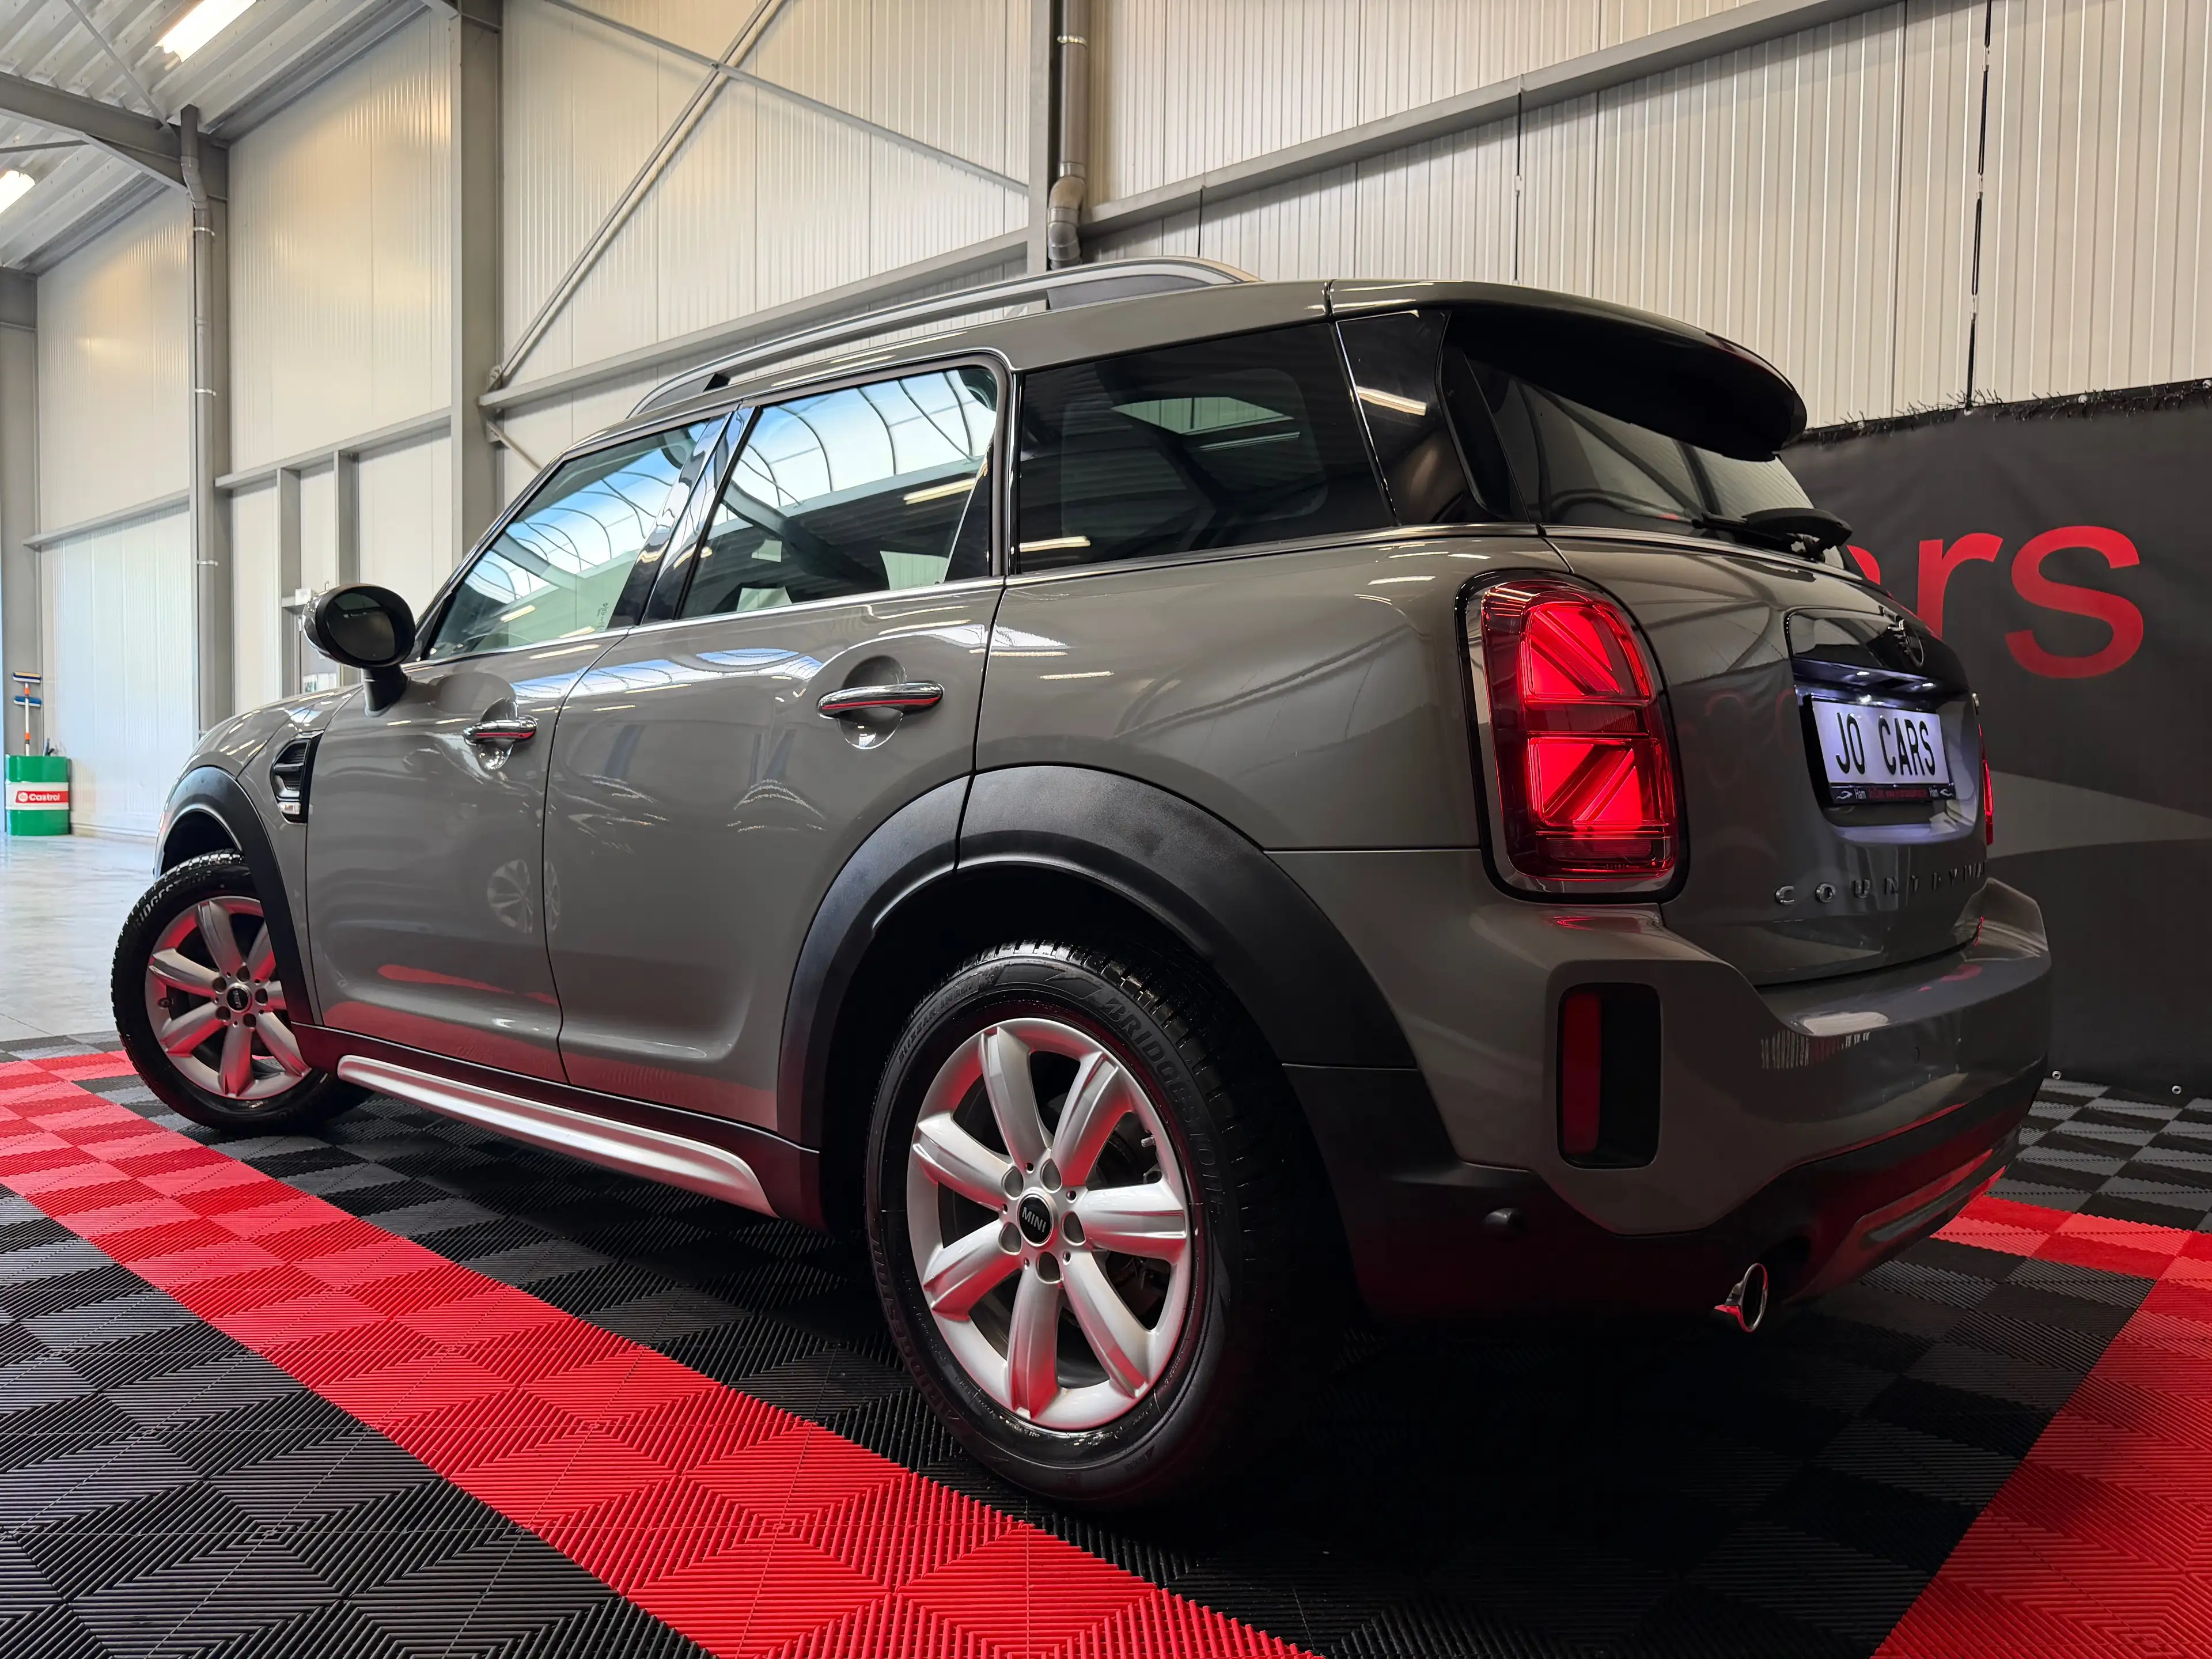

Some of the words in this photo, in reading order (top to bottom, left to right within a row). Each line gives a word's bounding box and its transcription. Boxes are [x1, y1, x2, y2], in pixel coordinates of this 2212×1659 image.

[1847, 525, 2144, 679] rs
[1835, 712, 1866, 775] JO
[1877, 717, 1936, 777] CARS
[29, 793, 60, 801] Castrol
[1774, 862, 1985, 905] COUNTYM
[1022, 1207, 1047, 1233] MINI
